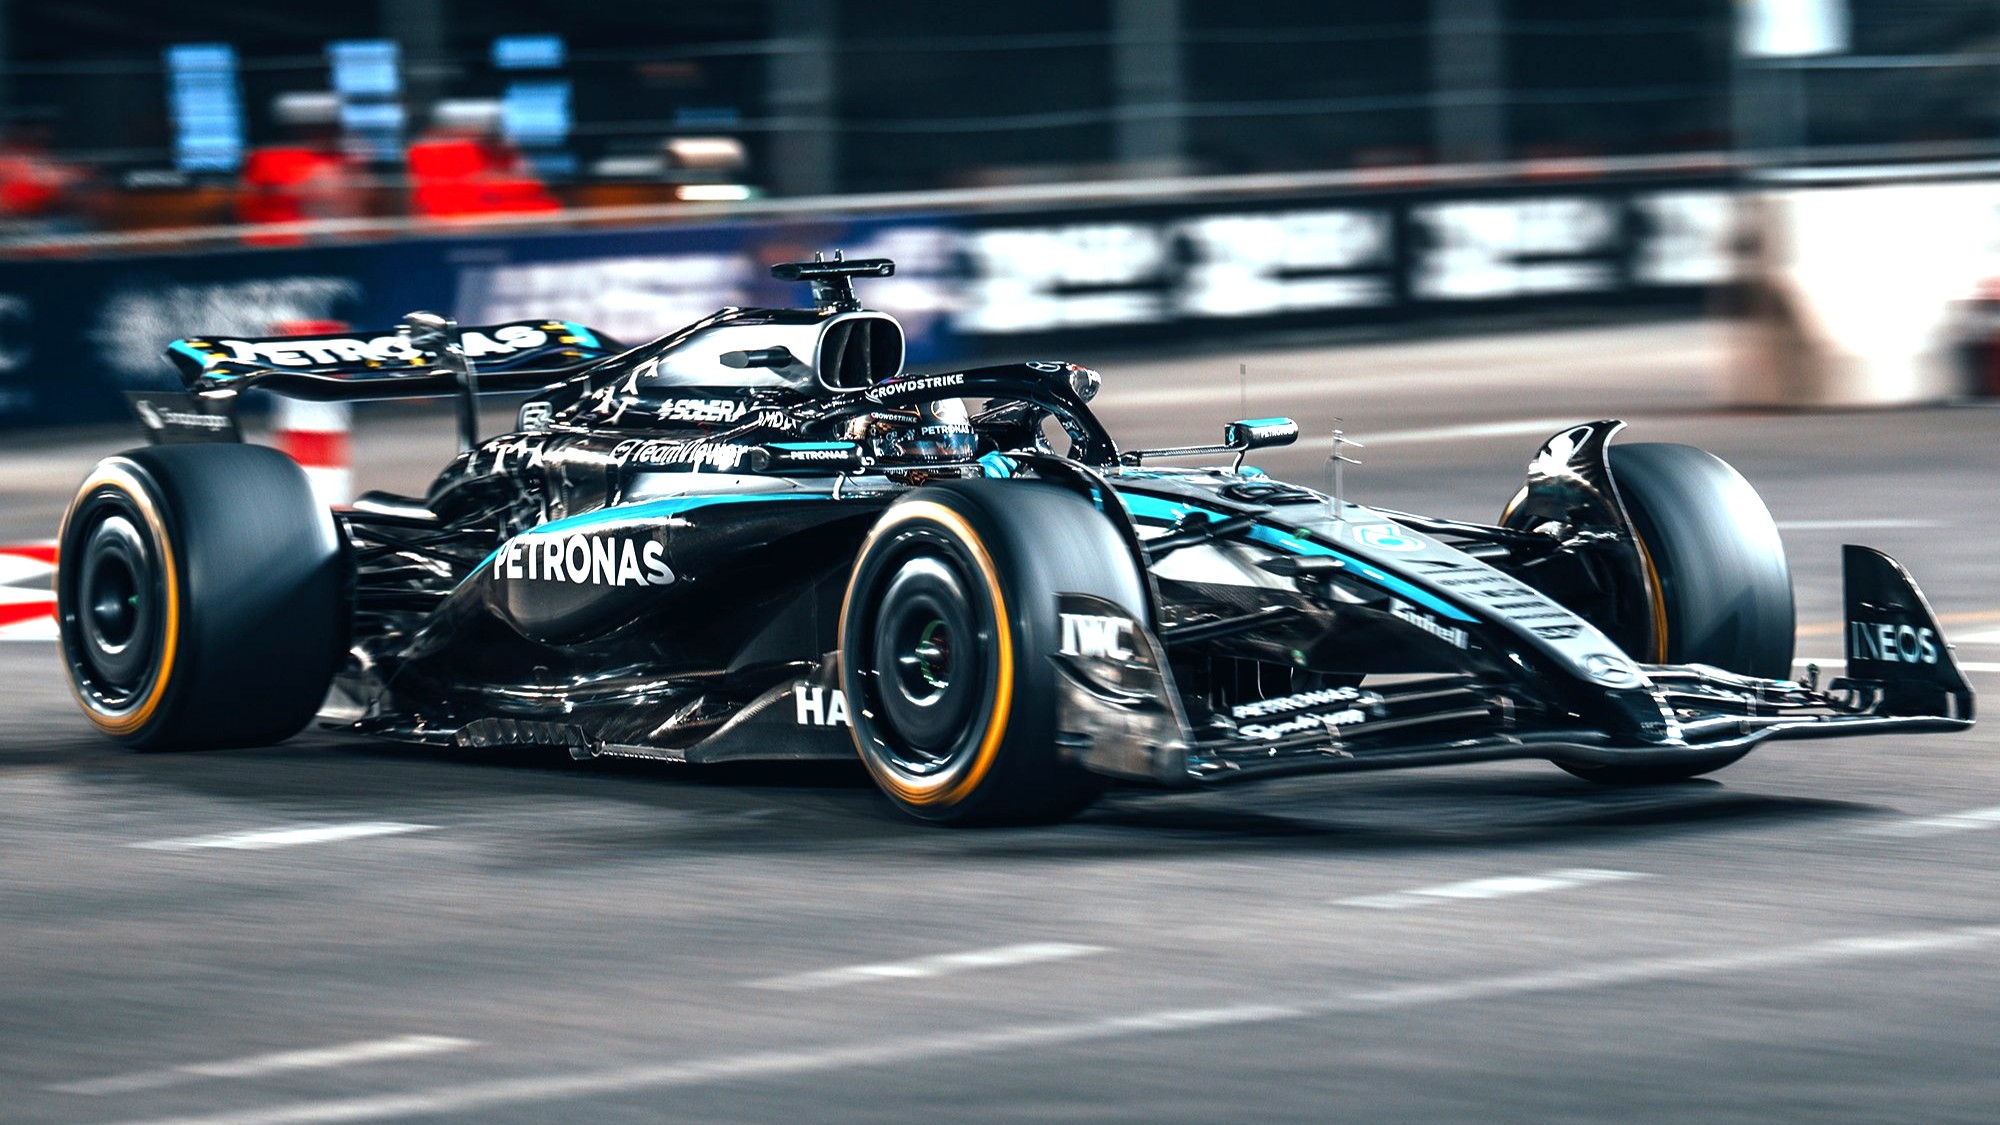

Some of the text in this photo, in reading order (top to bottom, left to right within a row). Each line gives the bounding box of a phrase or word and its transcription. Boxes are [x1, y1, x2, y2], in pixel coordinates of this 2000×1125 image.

[220, 326, 548, 366] PETROAS
[870, 373, 965, 398] CROWDSTRIKE
[870, 411, 918, 424] CROWDSTRIKE
[790, 450, 849, 460] PETRONAS
[494, 533, 676, 587] PETRONAS
[1058, 613, 1135, 661] IWC
[1851, 621, 1938, 665] INEOS
